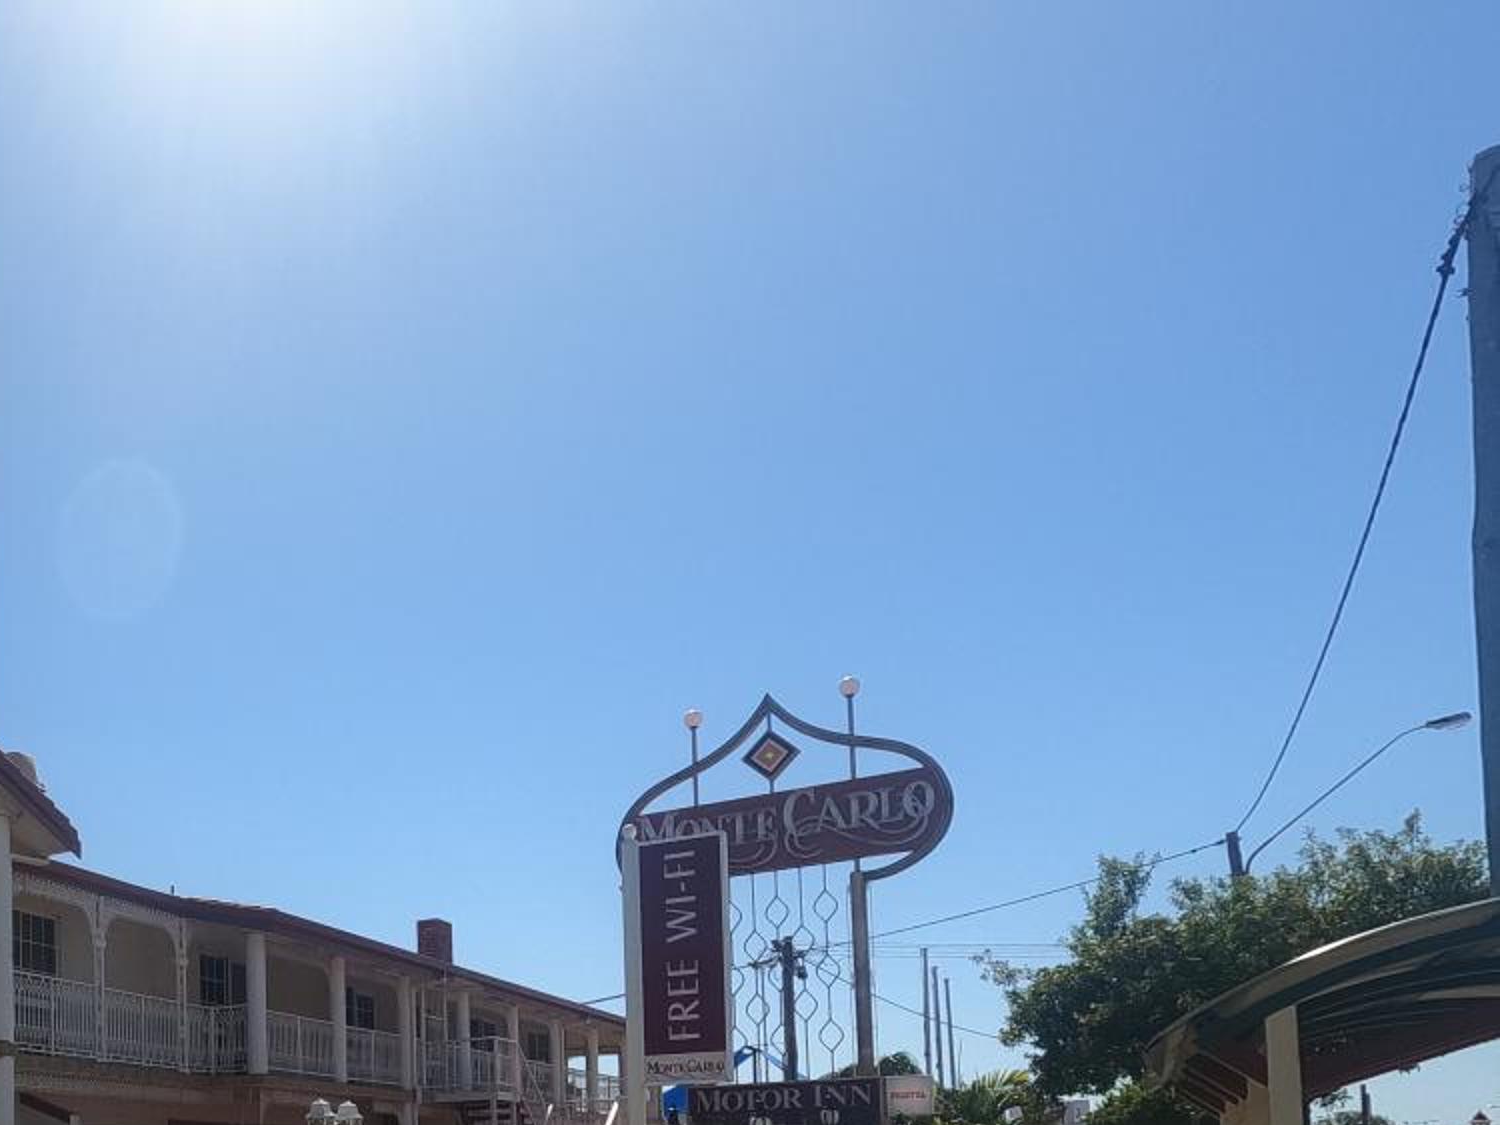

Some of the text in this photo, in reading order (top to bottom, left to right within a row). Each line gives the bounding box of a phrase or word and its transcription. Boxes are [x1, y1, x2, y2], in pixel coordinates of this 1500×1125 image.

[781, 780, 936, 854] CARLO
[663, 850, 701, 1041] FREE WI-FI
[697, 1083, 871, 1113] MOTOR INN
